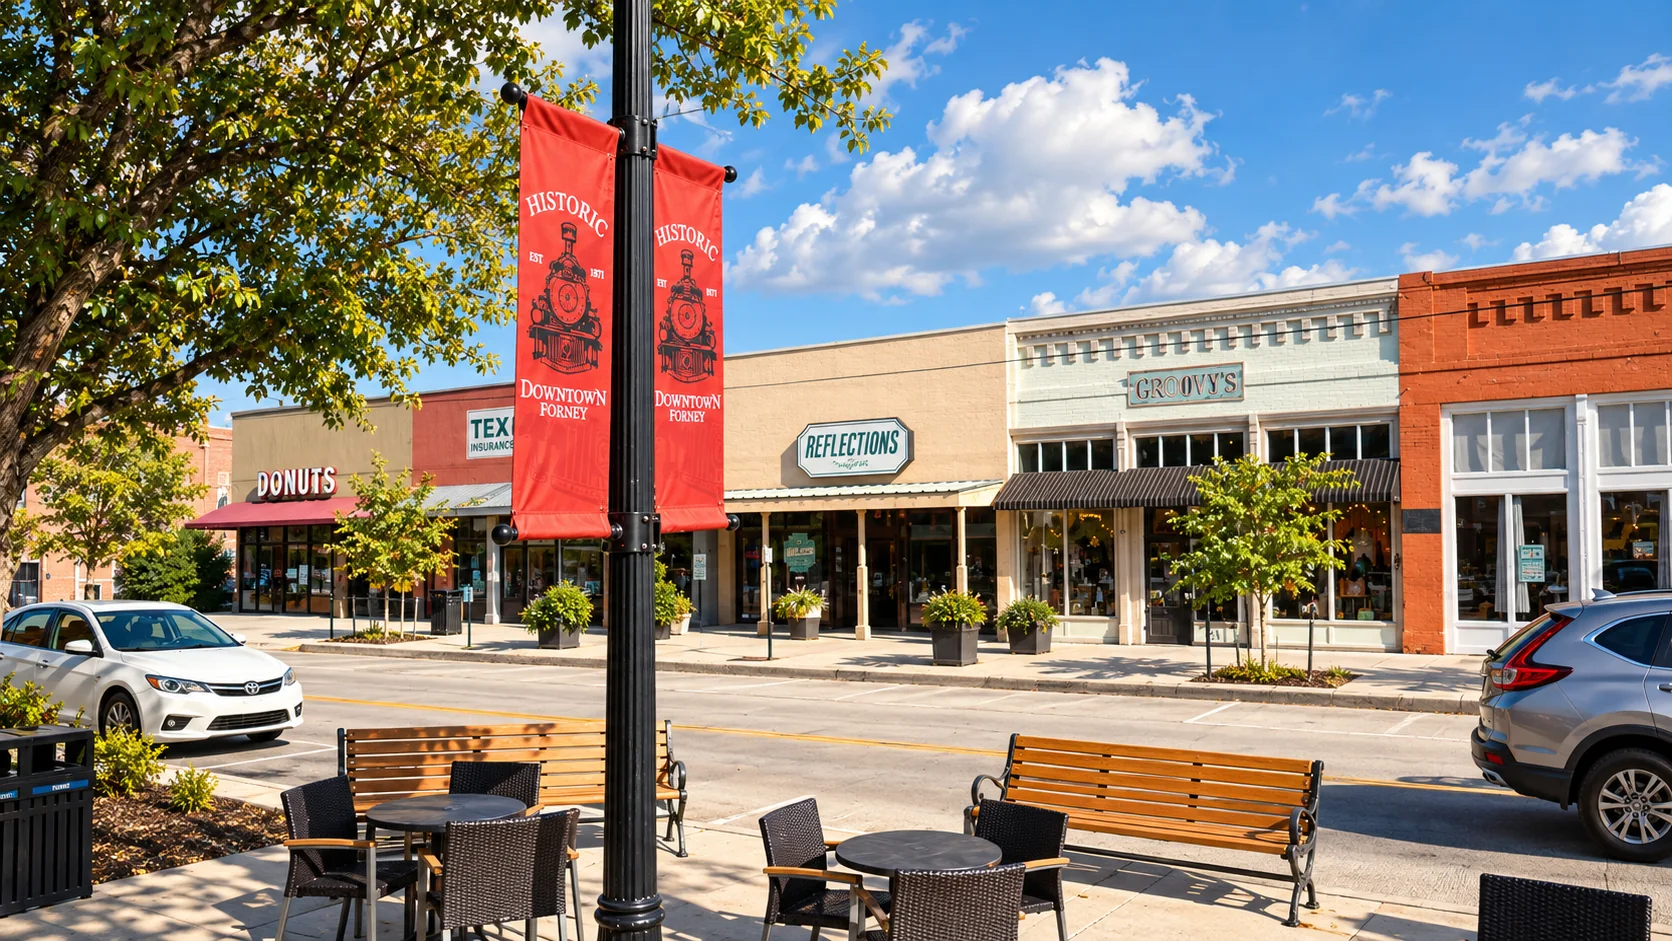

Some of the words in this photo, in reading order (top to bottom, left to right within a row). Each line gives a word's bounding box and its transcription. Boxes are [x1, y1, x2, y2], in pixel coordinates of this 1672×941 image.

[525, 190, 608, 238] HISTORIC
[655, 223, 719, 262] HISTORIC
[529, 251, 543, 264] EST
[520, 378, 607, 406] DOWNTOWN
[655, 390, 721, 410] DOWNTOWN
[1135, 372, 1237, 400] GROOVY'S
[540, 402, 588, 421] FORNEY
[669, 410, 705, 423] FORNEY
[470, 417, 514, 439] TEX
[805, 430, 899, 458] REFLECTIONS
[257, 466, 337, 498] DONUTS
